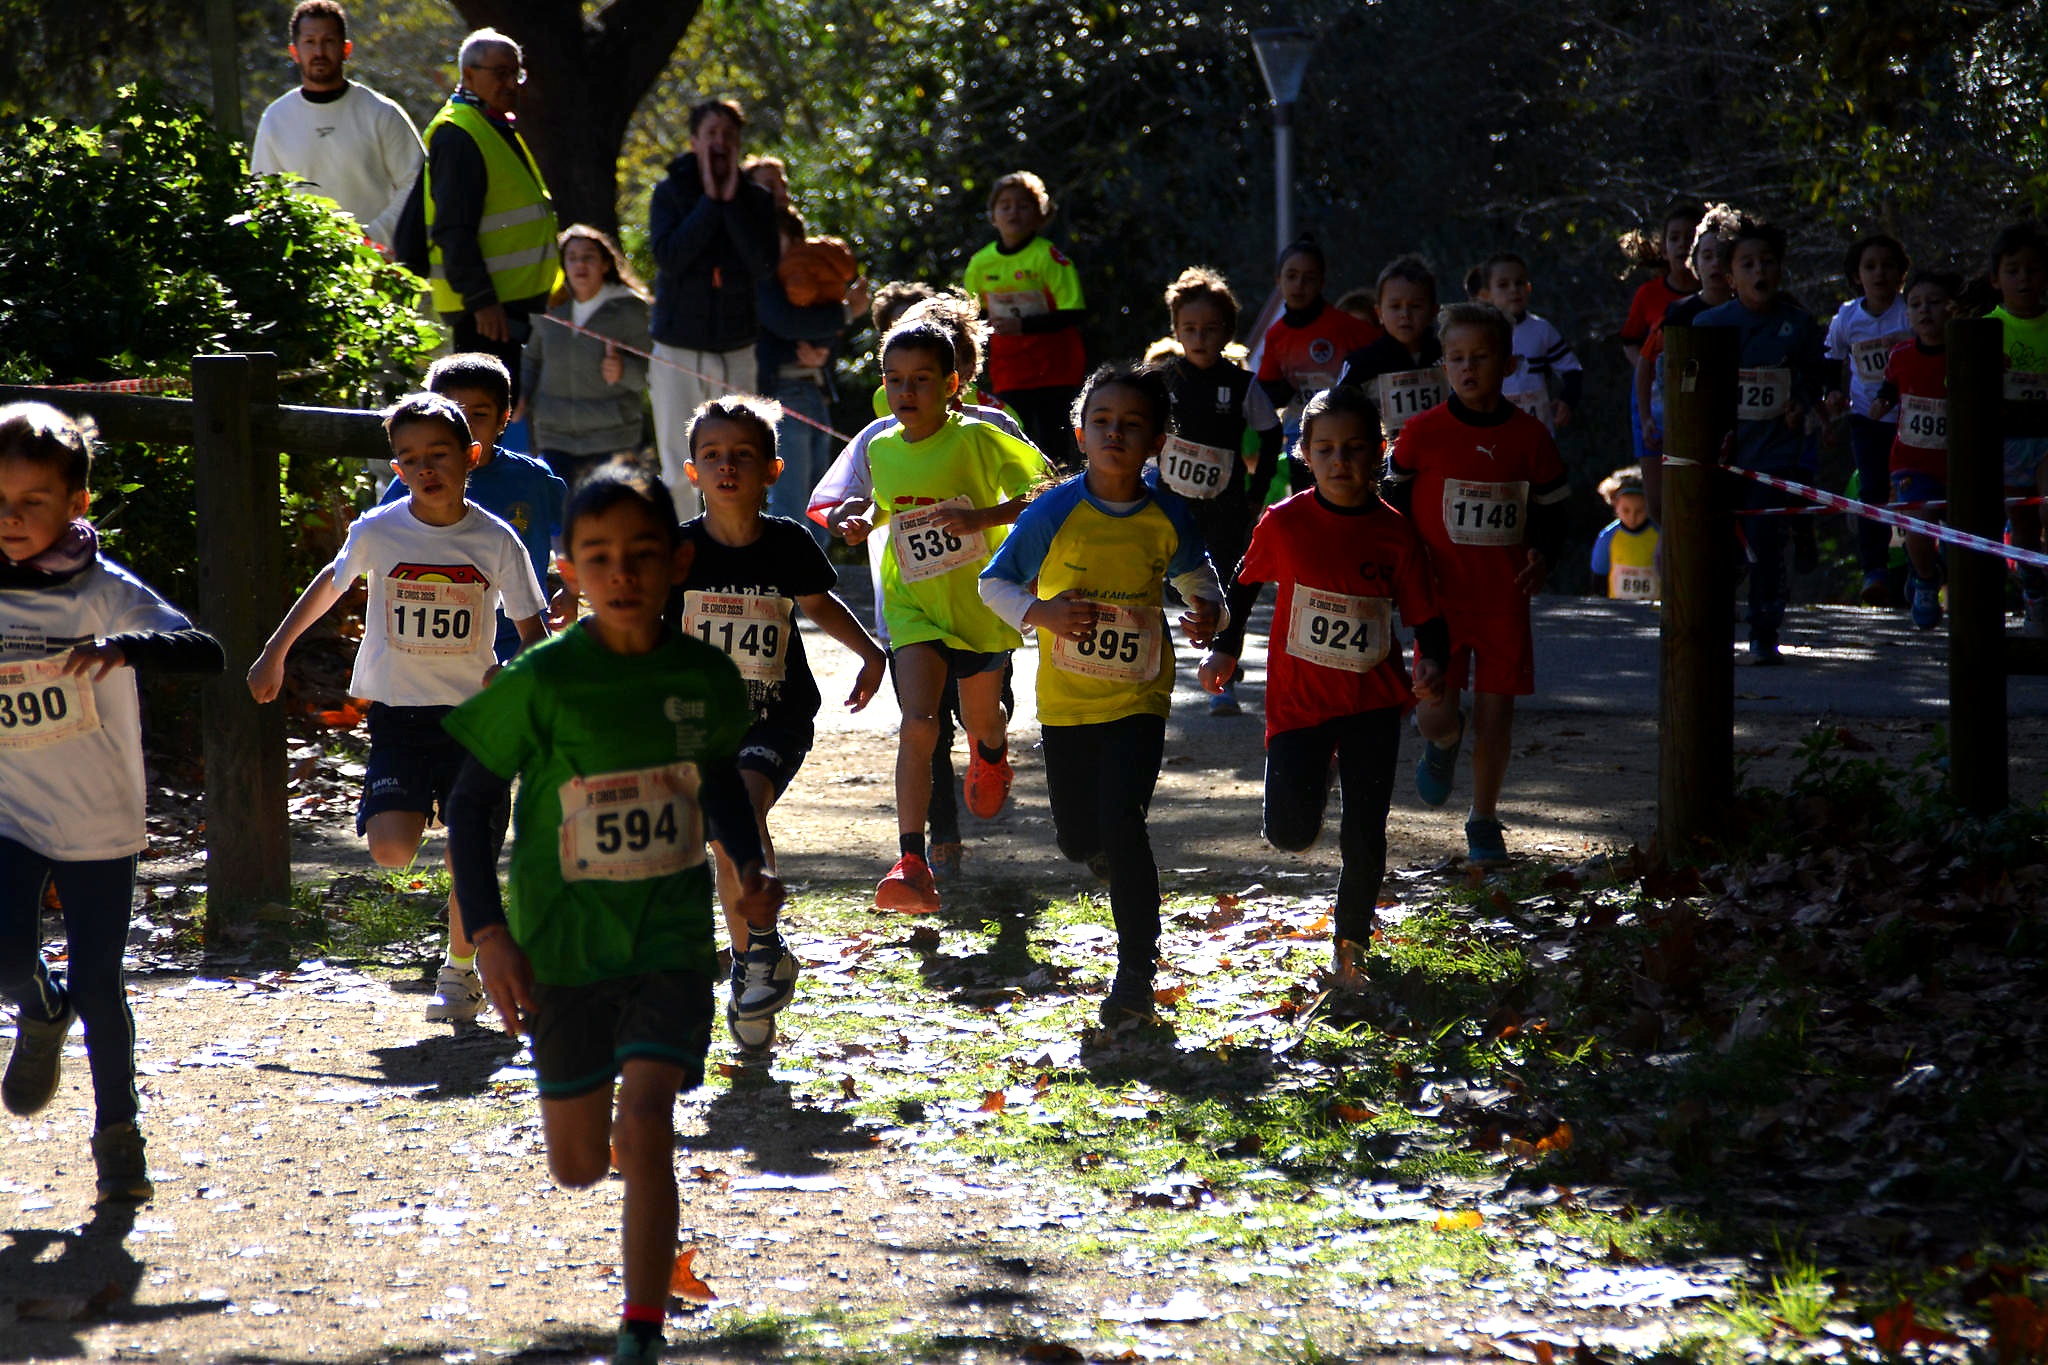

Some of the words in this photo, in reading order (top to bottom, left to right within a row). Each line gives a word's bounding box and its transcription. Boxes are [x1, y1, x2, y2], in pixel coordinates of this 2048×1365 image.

[1862, 350, 1889, 371] 10
[1392, 386, 1440, 413] 1151
[1910, 414, 1948, 436] 498
[1169, 456, 1220, 486] 1068
[1454, 501, 1517, 529] 1148
[908, 524, 962, 561] 538
[1623, 579, 1650, 593] 896
[394, 605, 471, 639] 1150
[702, 603, 709, 612] DE
[710, 603, 727, 614] CROS
[727, 604, 744, 615] 2025
[697, 620, 779, 658] 1149
[1077, 629, 1140, 663] 895
[1310, 615, 1369, 653] 924
[0, 686, 67, 728] 390
[596, 803, 678, 854] 594
